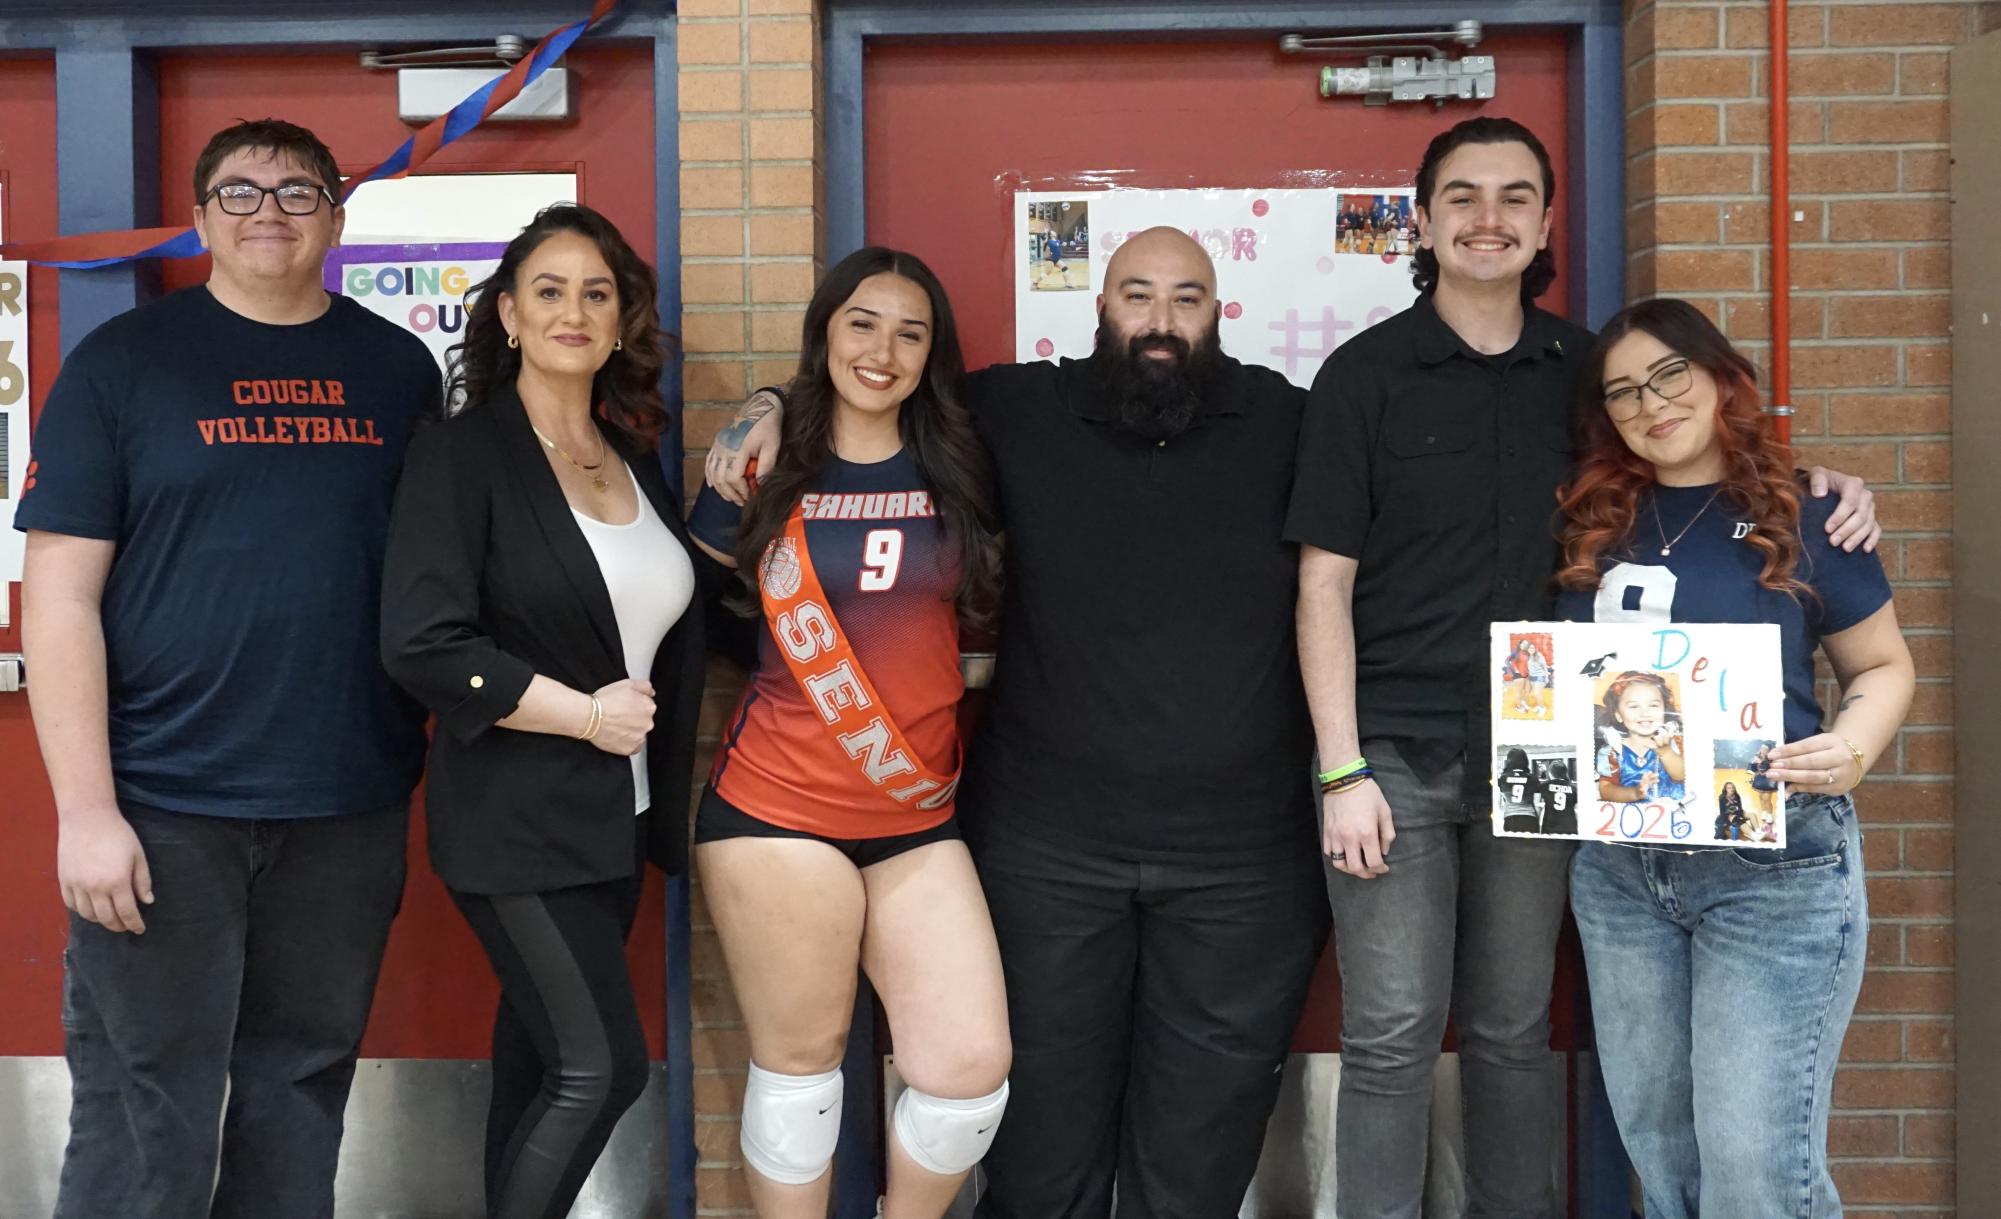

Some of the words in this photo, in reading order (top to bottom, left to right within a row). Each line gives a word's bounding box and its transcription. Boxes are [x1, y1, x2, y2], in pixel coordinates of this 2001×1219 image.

[346, 267, 469, 297] GOING
[409, 304, 474, 333] OU
[233, 380, 346, 406] COUGAR
[197, 416, 384, 446] VOLLEYBALL
[801, 490, 938, 519] SAHUAR
[859, 528, 904, 592] 9
[1652, 629, 1763, 732] Dela
[1512, 785, 1525, 803] 9
[1553, 792, 1567, 811] 9
[1595, 802, 1693, 840] 2026
